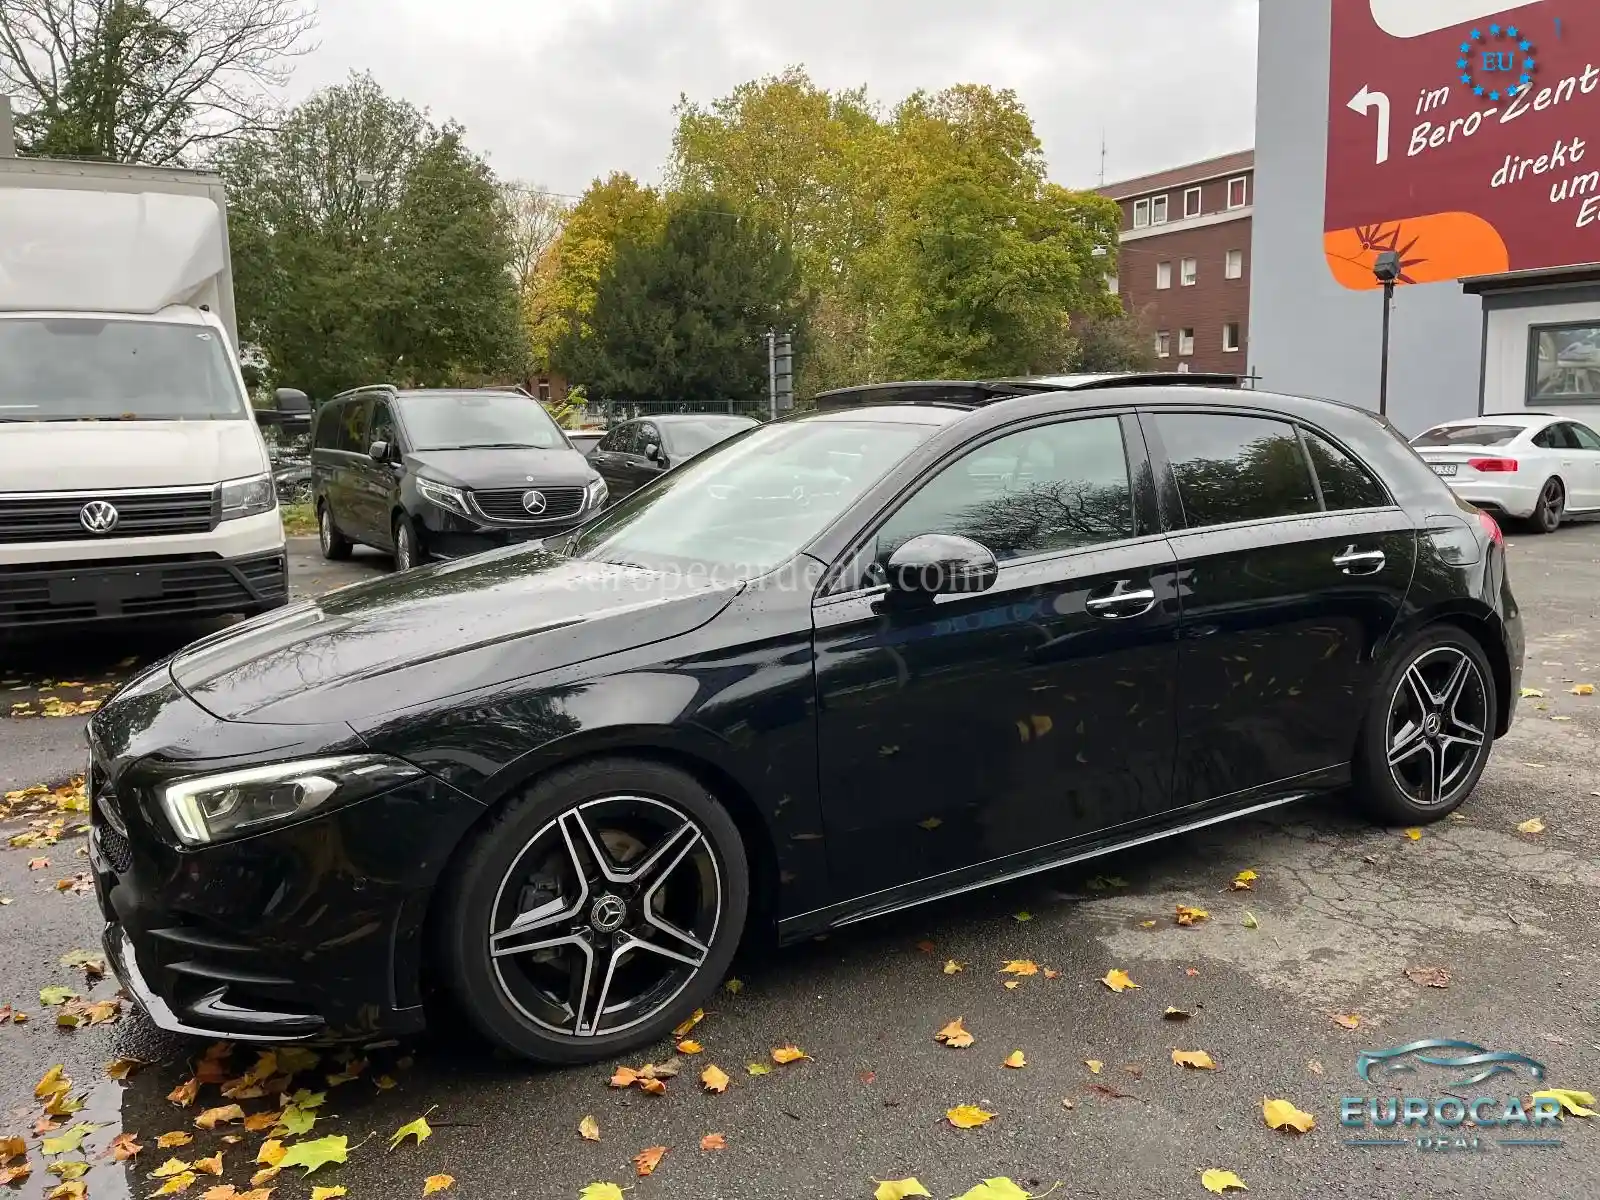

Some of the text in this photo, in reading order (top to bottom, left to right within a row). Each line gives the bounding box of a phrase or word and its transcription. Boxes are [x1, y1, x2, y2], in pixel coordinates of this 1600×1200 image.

[1416, 86, 1450, 115] im
[1490, 136, 1586, 188] direkt
[1575, 194, 1600, 228] E
